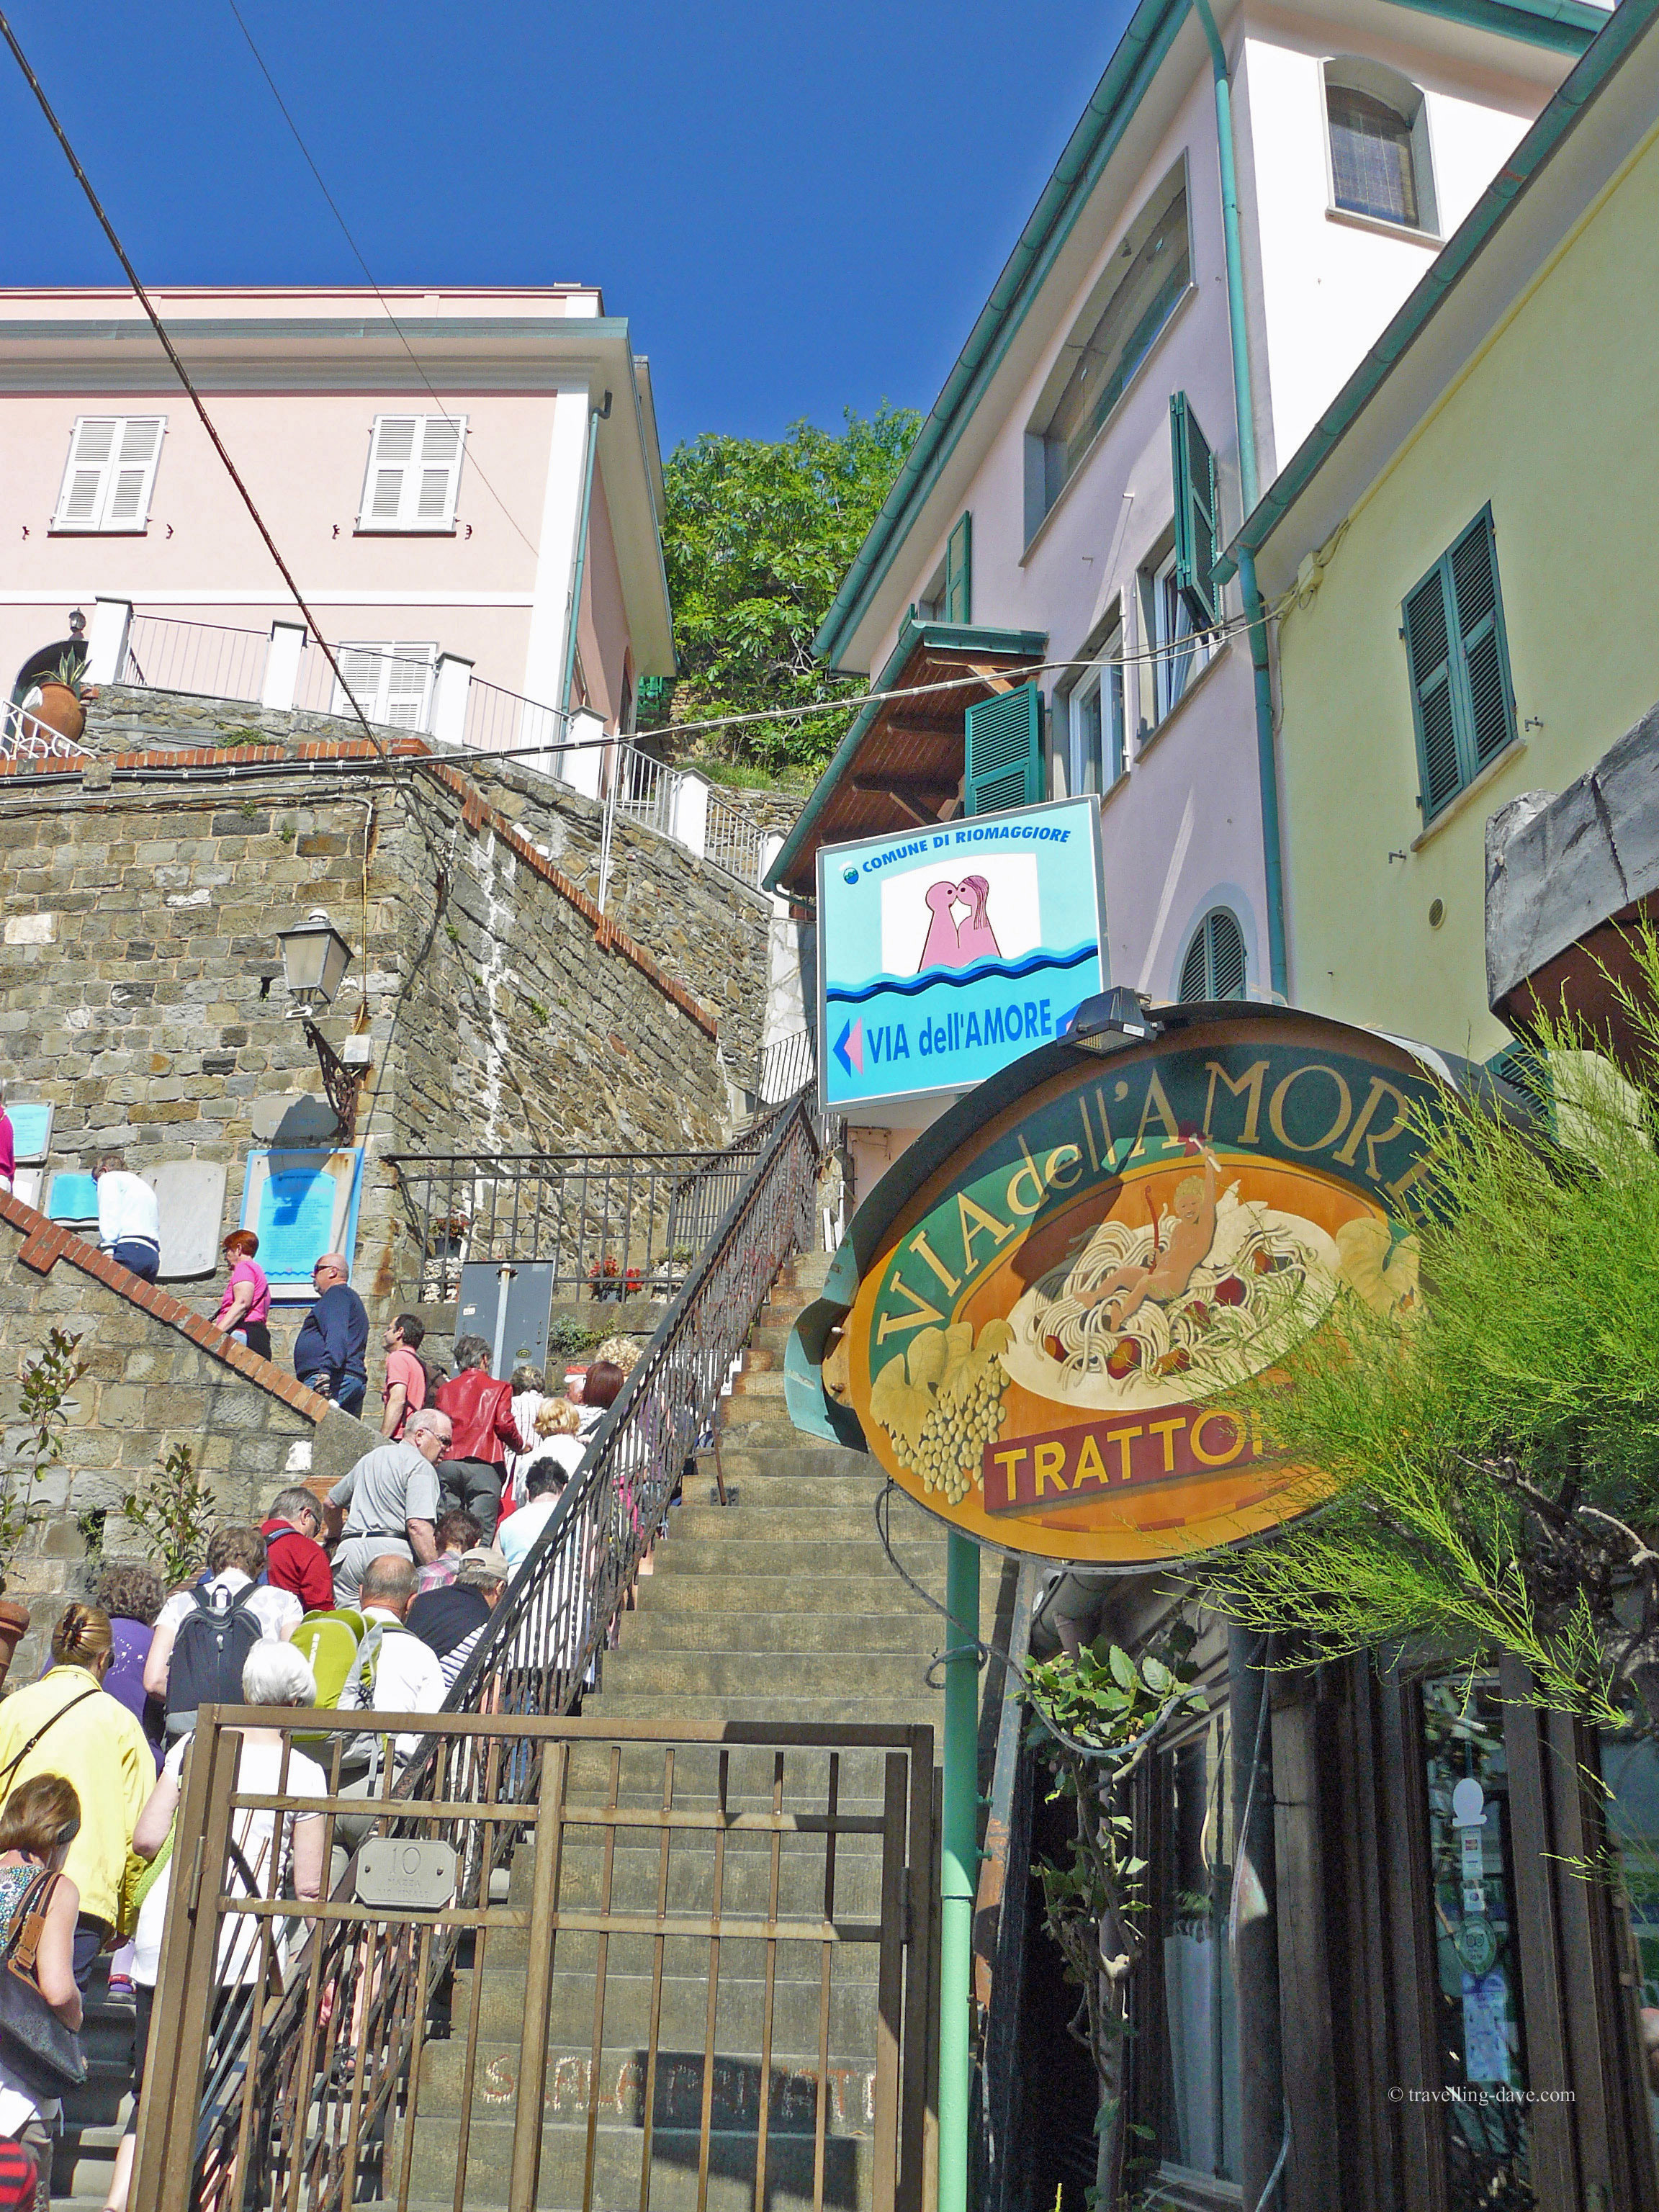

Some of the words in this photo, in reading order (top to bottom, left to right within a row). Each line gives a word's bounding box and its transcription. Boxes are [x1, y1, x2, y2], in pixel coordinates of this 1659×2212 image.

[862, 840, 928, 873] COMUNE
[933, 835, 950, 849] DI
[955, 825, 1071, 844] RIOMAGGIORE
[867, 1023, 910, 1064] VIA
[919, 999, 1052, 1056] dell'AMORE
[876, 1192, 1015, 1345] VIA
[391, 1845, 421, 1874] 10
